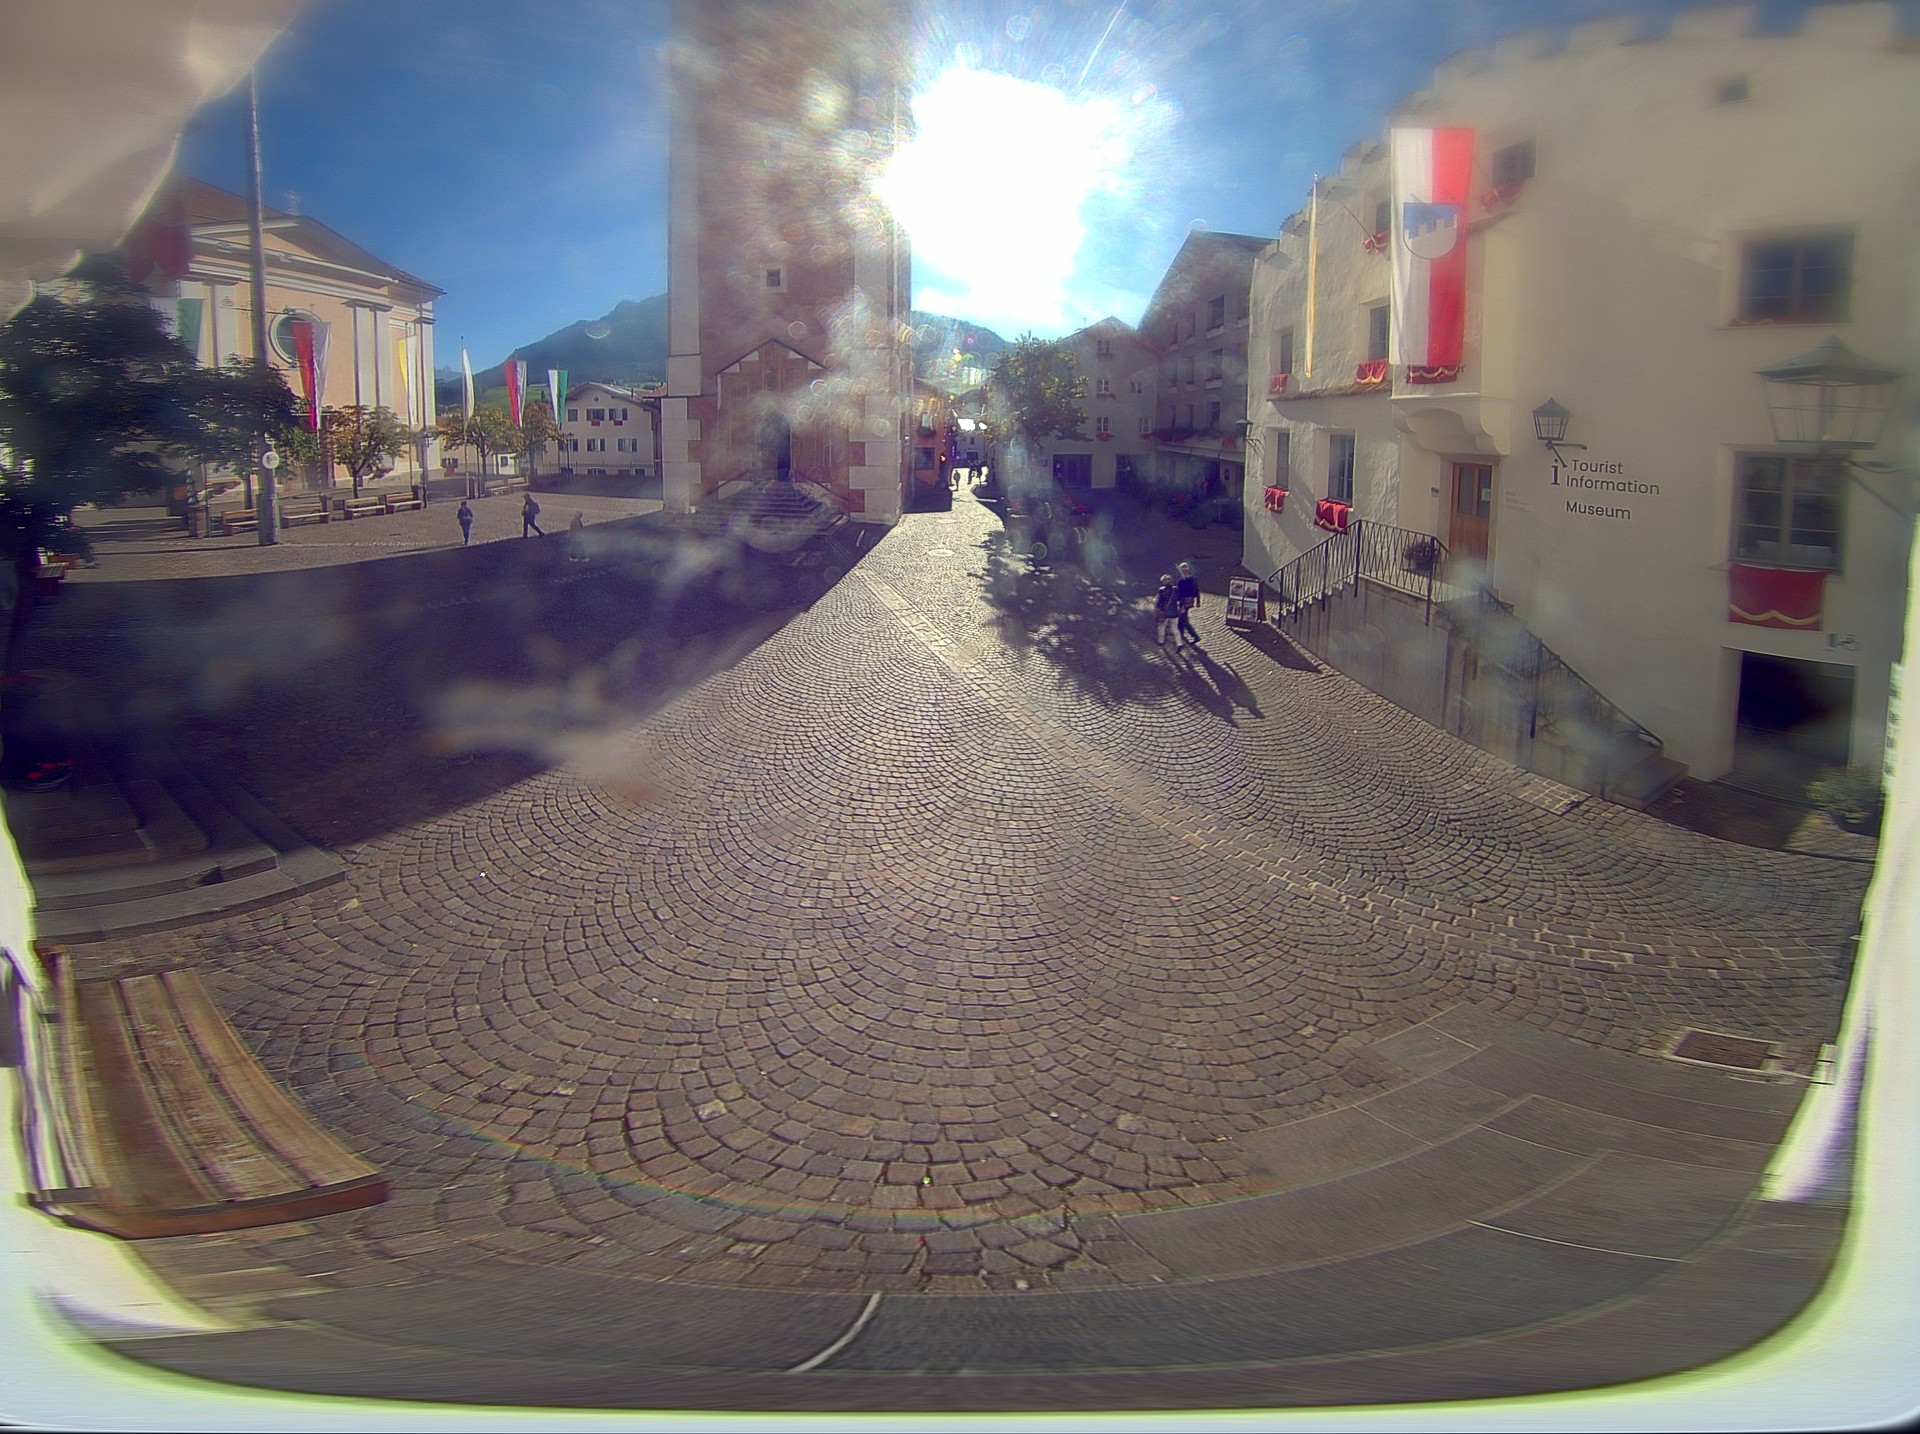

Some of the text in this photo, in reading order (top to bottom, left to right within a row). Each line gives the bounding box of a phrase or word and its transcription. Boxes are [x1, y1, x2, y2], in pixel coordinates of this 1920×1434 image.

[1572, 459, 1623, 475] Tourist
[1566, 475, 1660, 495] Information
[1566, 501, 1631, 520] Museum
